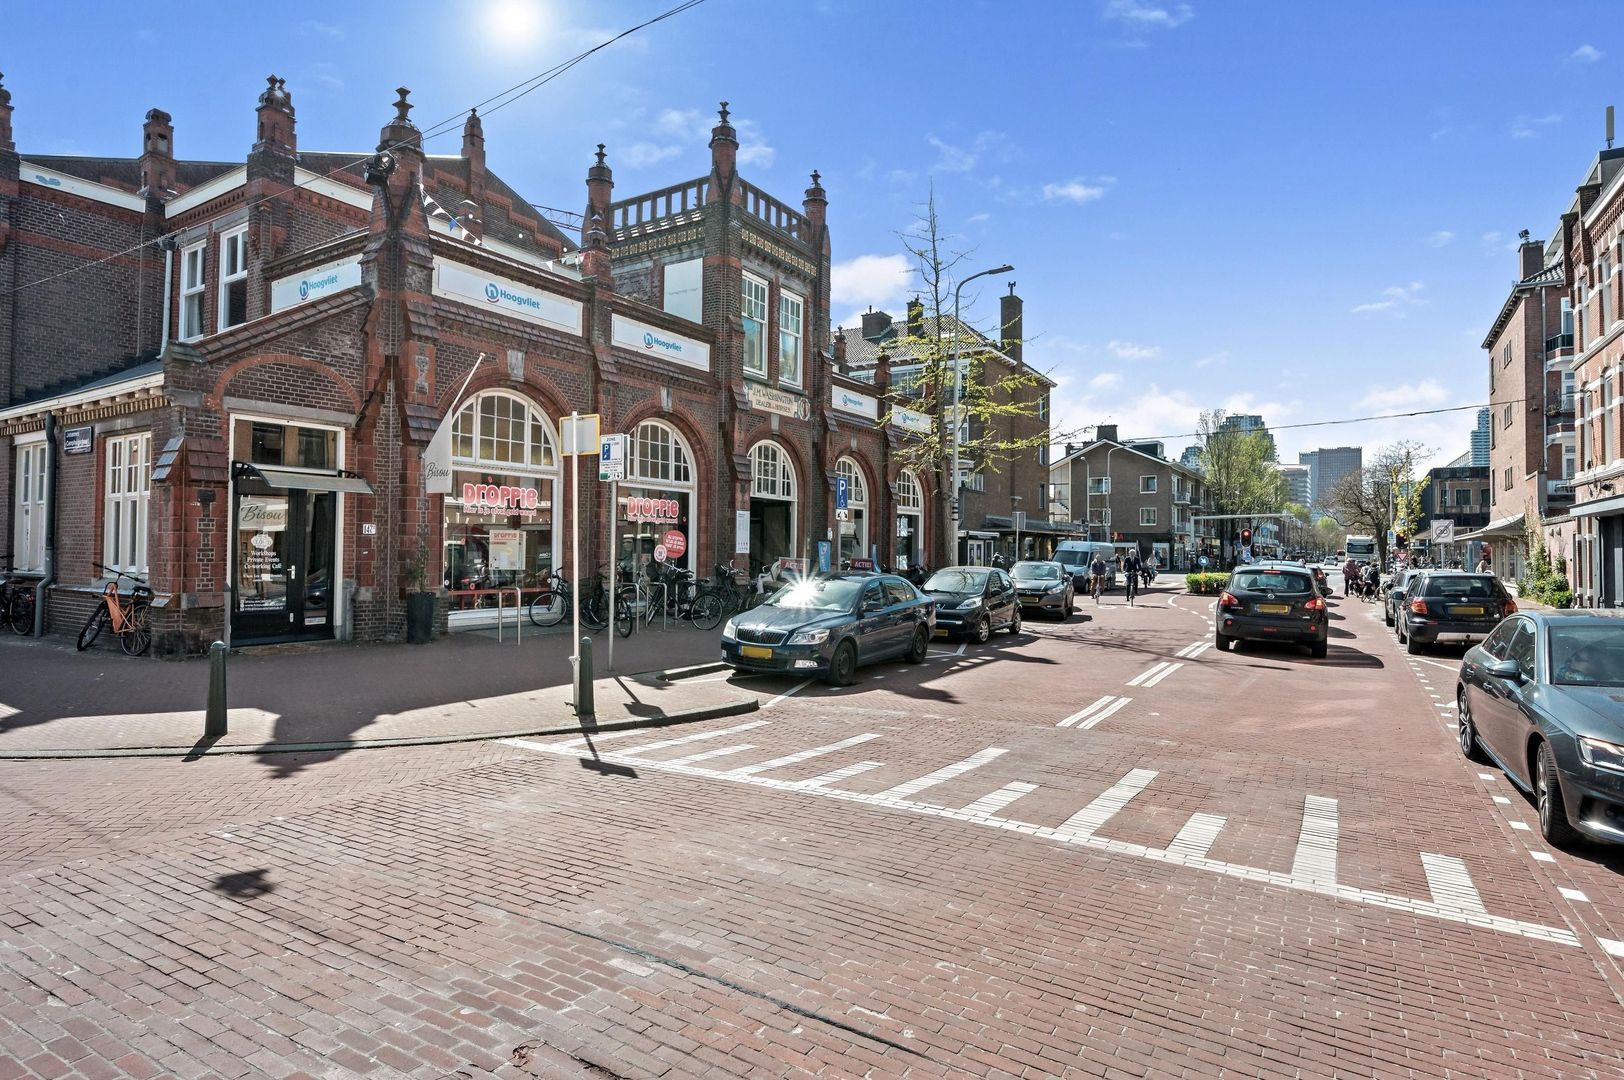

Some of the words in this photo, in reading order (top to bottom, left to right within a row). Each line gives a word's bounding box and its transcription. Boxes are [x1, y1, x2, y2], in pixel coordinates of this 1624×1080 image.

[309, 275, 338, 289] Hoogvliet
[500, 289, 540, 309] Hoogvliet
[653, 337, 682, 352] Hoogvliet
[426, 461, 451, 480] Bisou
[839, 480, 846, 495] P
[241, 504, 285, 522] Bisou
